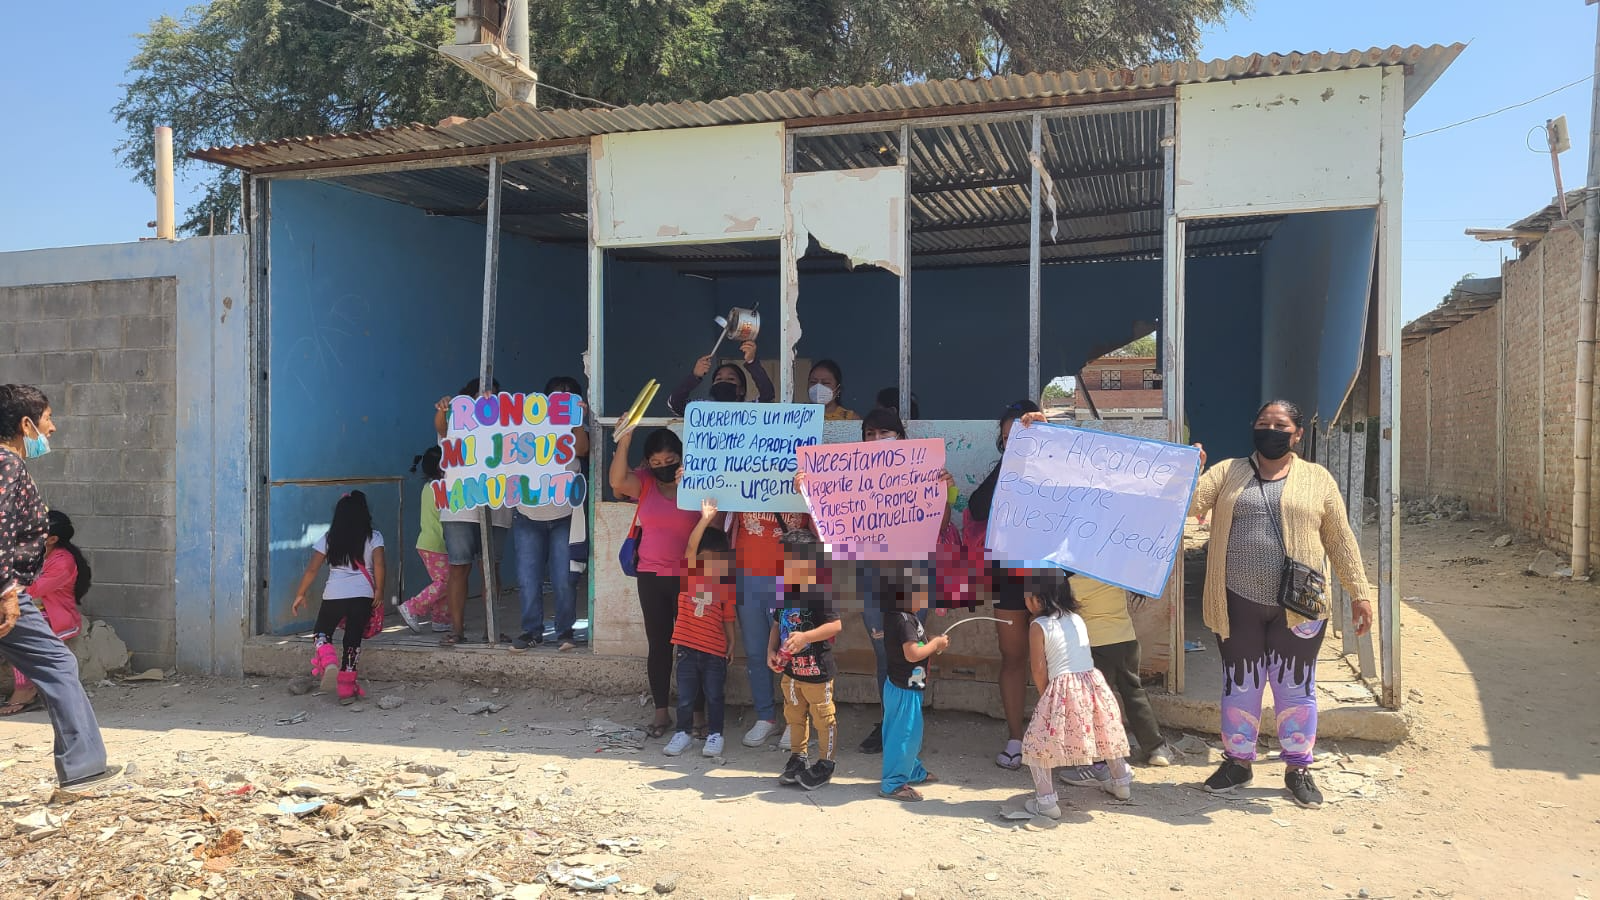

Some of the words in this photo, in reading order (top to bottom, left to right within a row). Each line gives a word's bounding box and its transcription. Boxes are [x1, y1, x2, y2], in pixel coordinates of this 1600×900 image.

[447, 393, 581, 431] RONOEI
[763, 410, 781, 425] un
[784, 407, 816, 429] mejor
[441, 435, 477, 468] MI
[485, 432, 574, 468] JESUS
[805, 448, 906, 473] Necesitamos
[1015, 428, 1053, 458] Sr.
[1066, 434, 1174, 485] Alcalde
[432, 473, 585, 513] MANUELITO
[741, 477, 798, 502] urgent
[821, 498, 867, 517] nuestro
[1000, 472, 1114, 510] escuche
[995, 500, 1098, 538] nuestro
[1096, 514, 1178, 562] pedido
